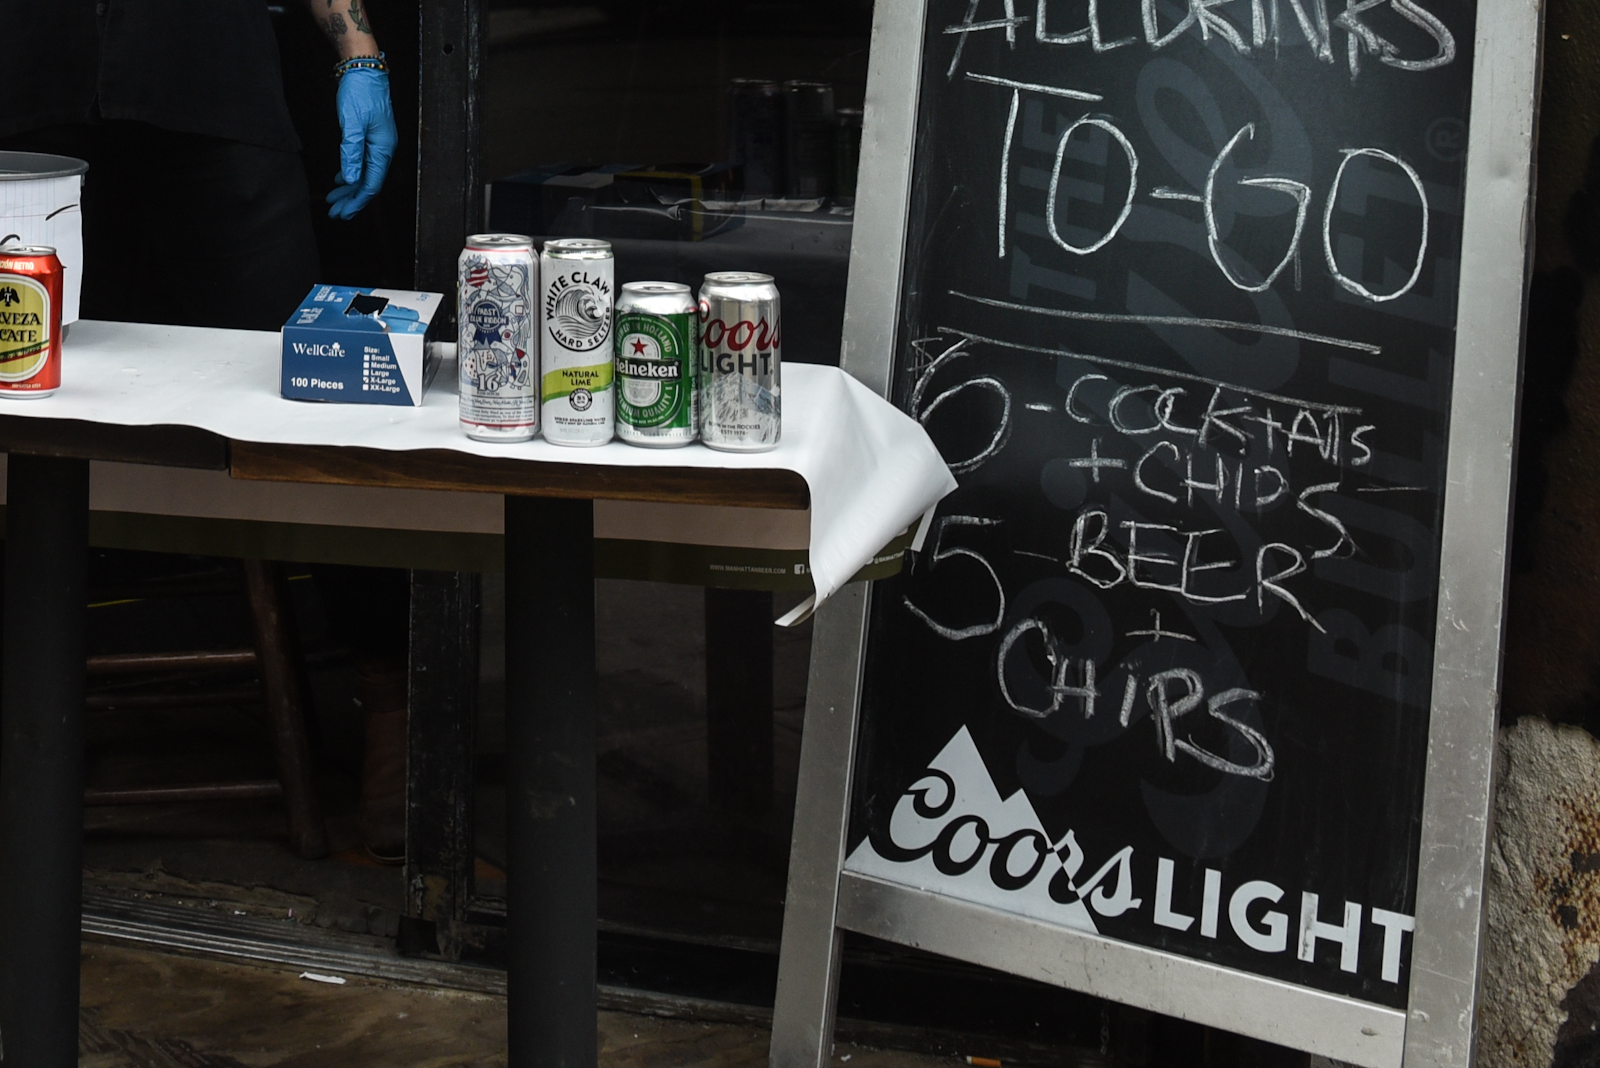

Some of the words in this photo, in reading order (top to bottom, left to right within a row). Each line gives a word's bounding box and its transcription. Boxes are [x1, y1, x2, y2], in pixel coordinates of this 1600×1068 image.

[965, 71, 1430, 304] TO-GO
[13, 260, 35, 271] RETRO
[545, 274, 569, 322] WHITE
[571, 271, 611, 295] CLAW
[555, 329, 584, 349] HARD
[587, 306, 611, 348] SELTZER
[643, 322, 673, 353] HOLLAND
[292, 341, 346, 358] WellCare
[371, 354, 390, 362] Small
[371, 362, 397, 370] Medium
[701, 349, 772, 377] LIGHT
[370, 369, 390, 378] Large
[370, 377, 396, 386] X-Large
[562, 369, 600, 379] NATURAL
[290, 376, 309, 388] 100
[310, 378, 345, 391] Pieces
[369, 385, 400, 394] XX-Large
[477, 372, 500, 393] 16
[570, 378, 592, 387] LIME
[642, 393, 672, 419] QUALITY
[1066, 510, 1328, 634] BEER
[867, 766, 1143, 918] Coors
[1152, 857, 1416, 985] LIGHT
